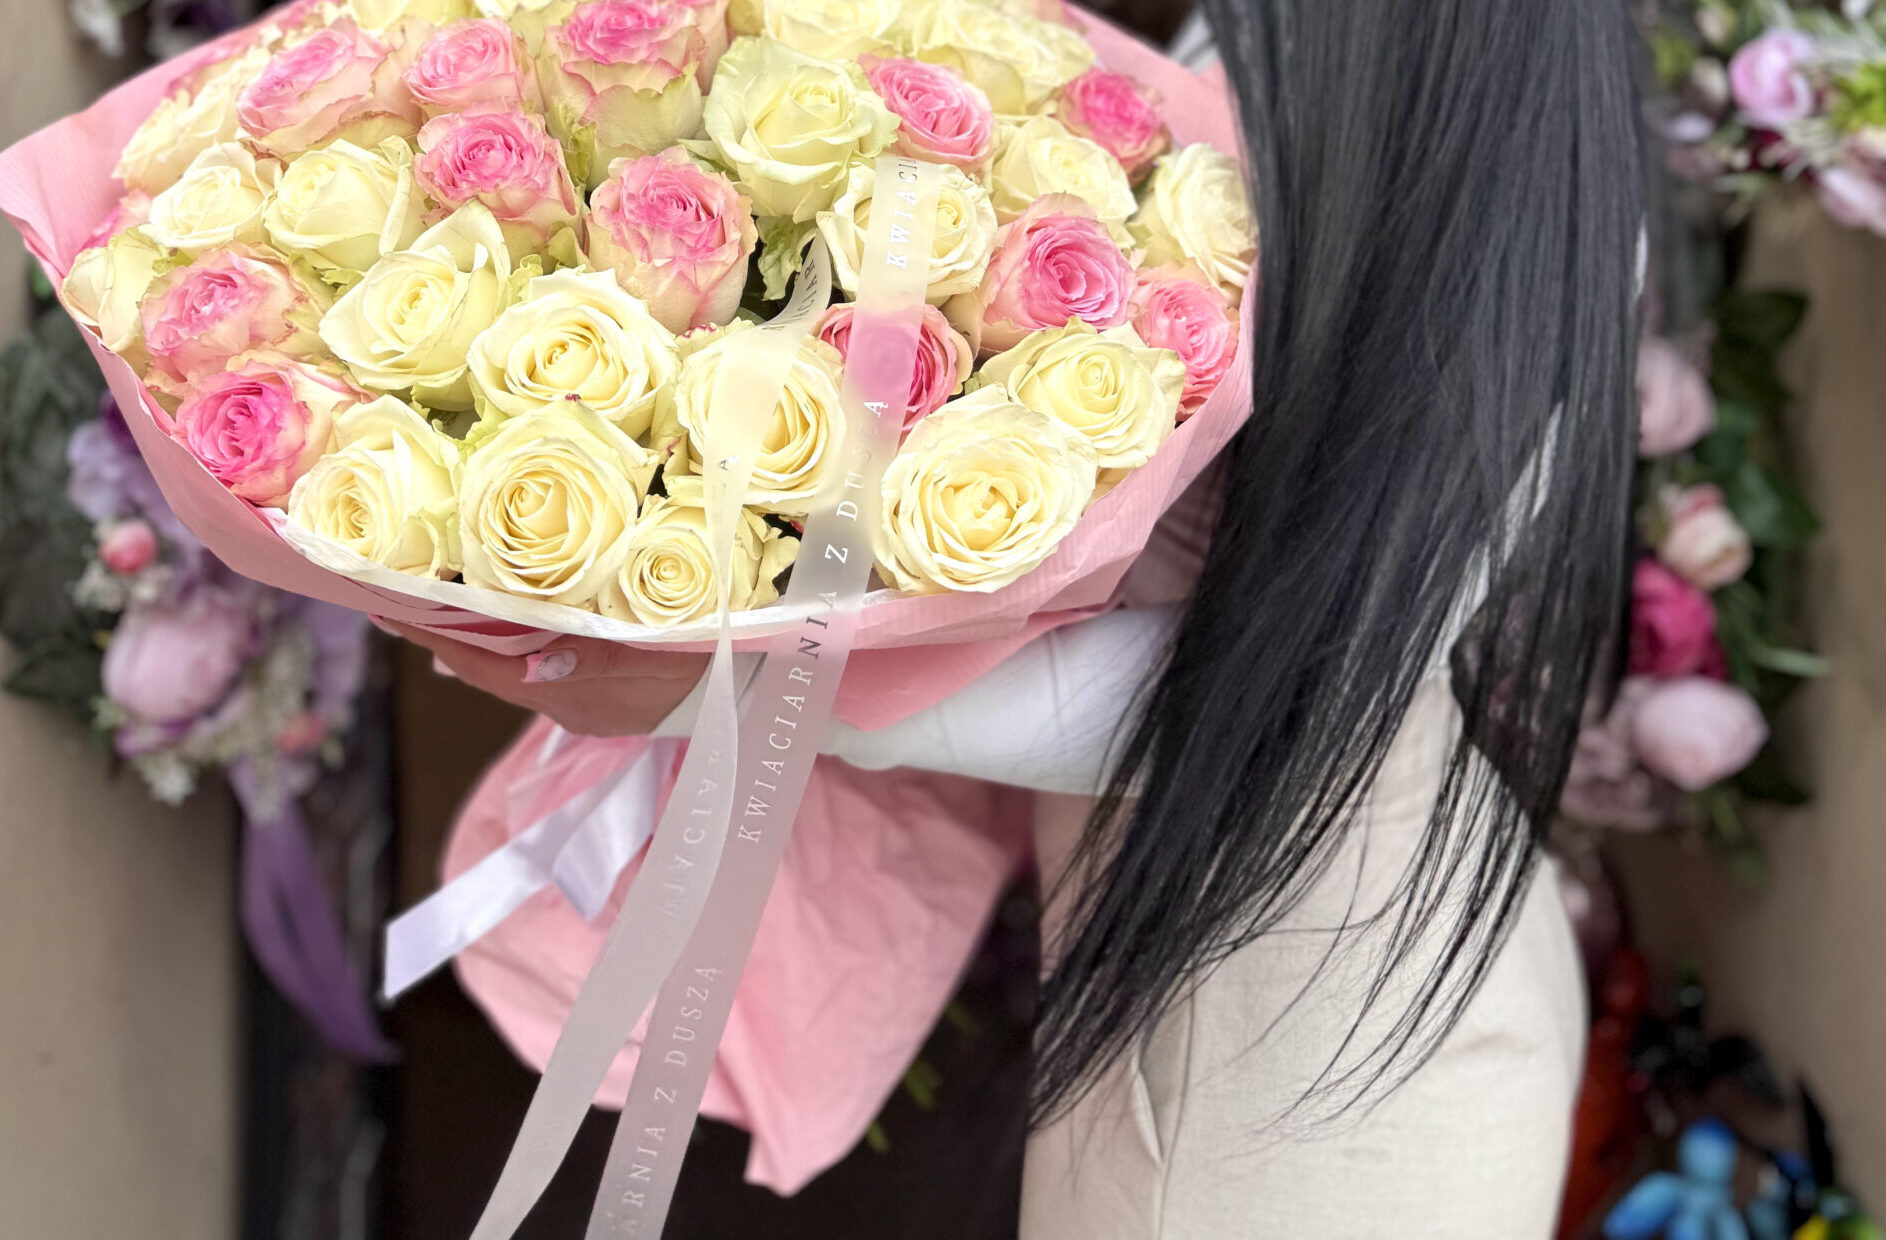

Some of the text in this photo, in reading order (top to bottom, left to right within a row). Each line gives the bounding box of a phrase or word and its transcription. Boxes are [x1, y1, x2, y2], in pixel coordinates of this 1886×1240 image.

[737, 590, 838, 843] KWIACIARNIA
[824, 543, 849, 565] Z
[664, 966, 723, 1068] DUSZĄ
[654, 1086, 678, 1104] Z
